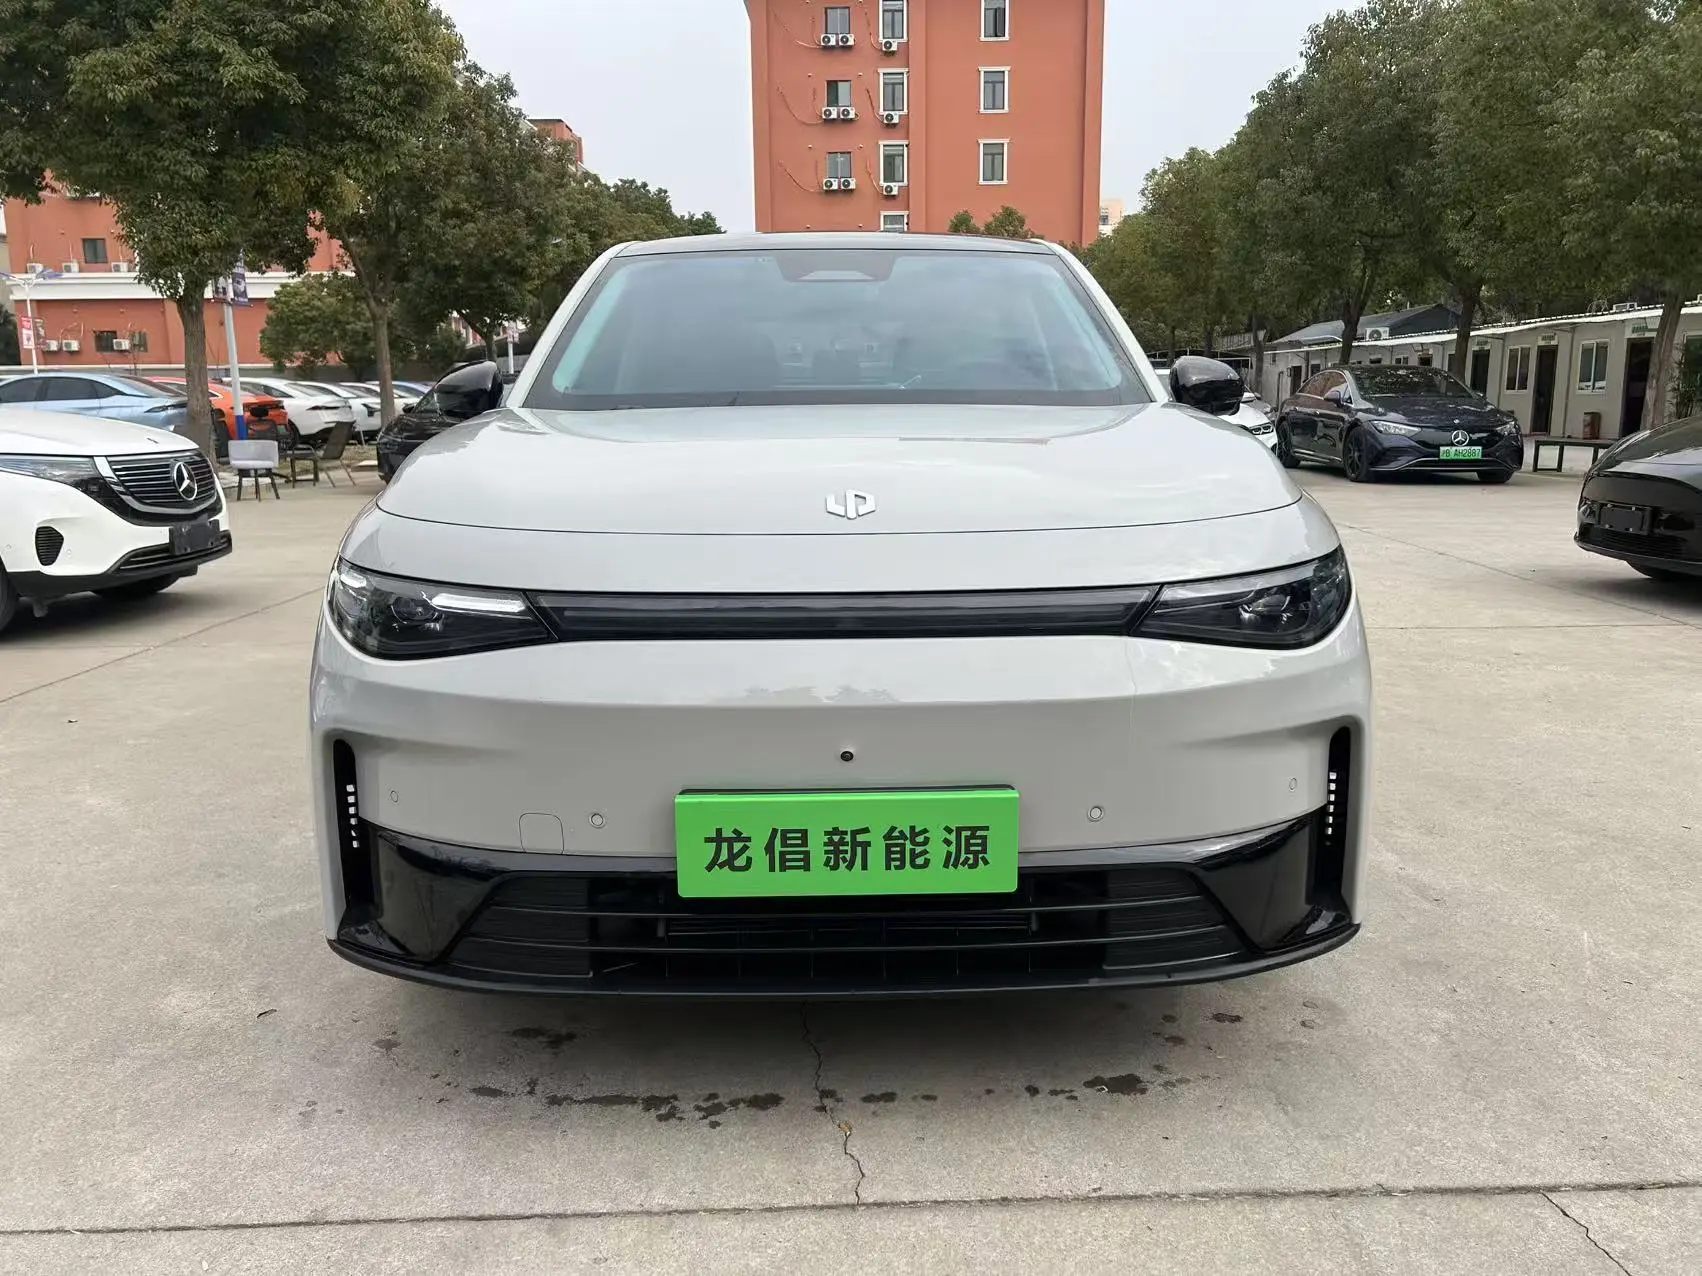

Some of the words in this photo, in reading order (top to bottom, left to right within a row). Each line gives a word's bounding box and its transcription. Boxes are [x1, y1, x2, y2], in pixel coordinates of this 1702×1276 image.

[704, 825, 991, 873] 龙倡新能源
